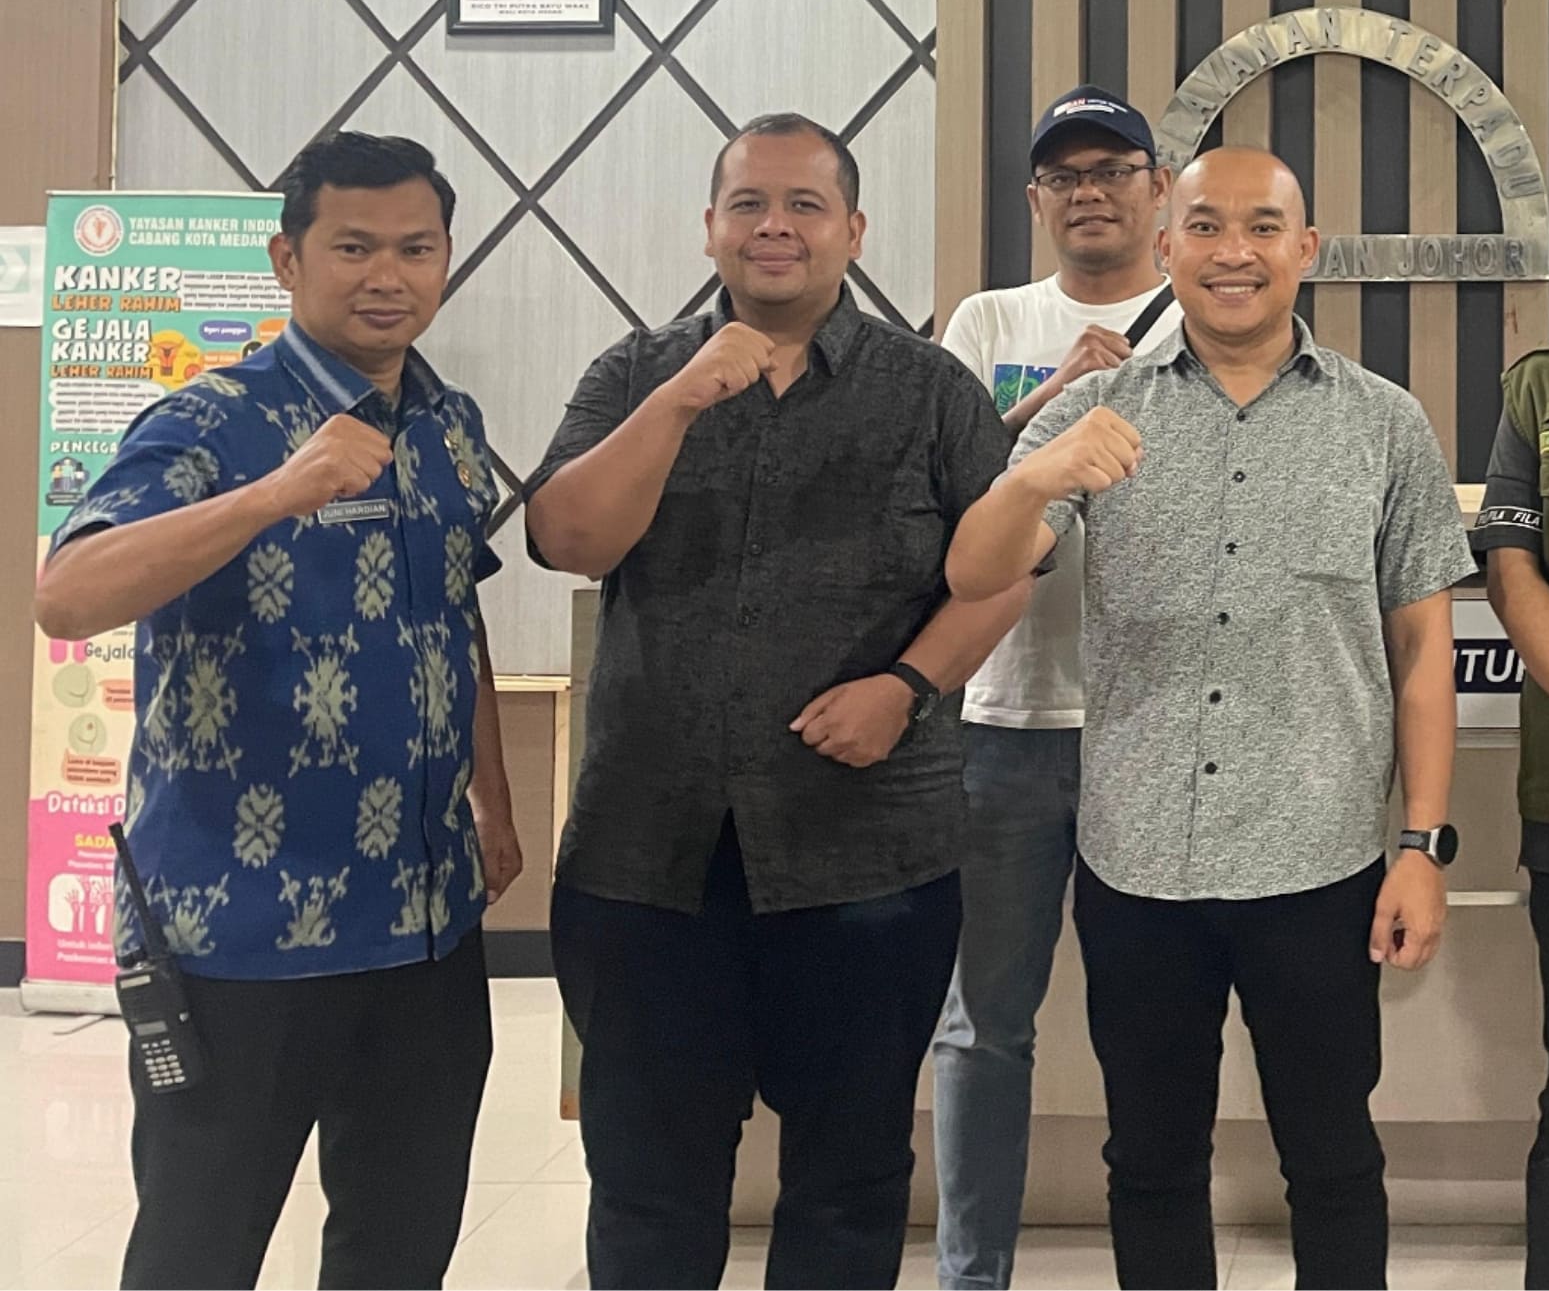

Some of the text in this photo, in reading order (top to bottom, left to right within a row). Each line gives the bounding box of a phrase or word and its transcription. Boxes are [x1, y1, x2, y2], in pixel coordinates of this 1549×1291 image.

[1155, 8, 1545, 201] ELAYANAN TERPADU
[129, 218, 184, 232] YAYASAN
[188, 218, 238, 232] KANKER
[128, 232, 267, 248] CABANG KOTA MEDAN
[1397, 235, 1527, 277] JOHOR
[54, 265, 182, 293] KANKER
[51, 294, 182, 313] LEHER RAHIM
[51, 318, 151, 341] GEJALA
[51, 342, 150, 363] KANKER
[50, 364, 152, 380] LEHER RAHIM
[50, 440, 119, 455] PENCEGA
[1512, 511, 1541, 526] FILA
[48, 793, 110, 816] Deteksi
